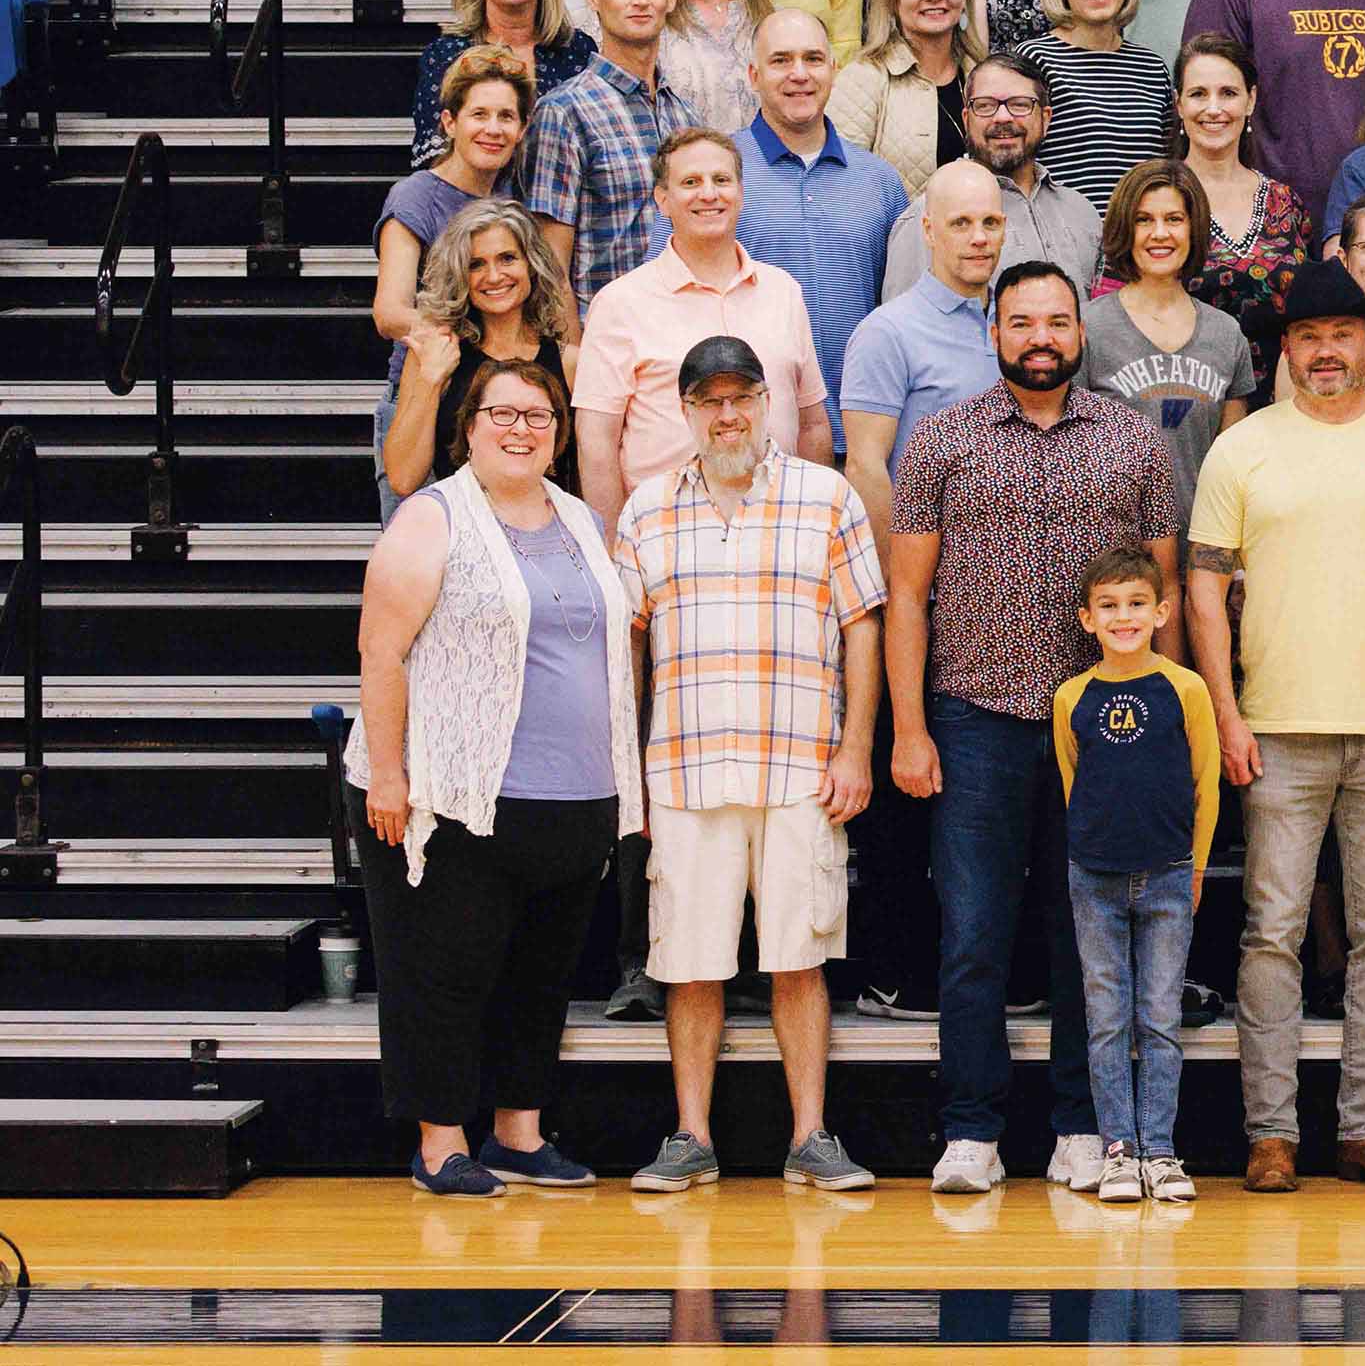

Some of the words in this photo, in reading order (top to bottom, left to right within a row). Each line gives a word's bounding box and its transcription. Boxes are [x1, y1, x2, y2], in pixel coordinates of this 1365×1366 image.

[1334, 42, 1352, 70] 7
[1109, 354, 1226, 403] WHEATON
[1161, 398, 1195, 429] W
[1098, 702, 1111, 717] SAN
[1112, 694, 1149, 716] FRANCISCO
[1109, 708, 1137, 730] CA
